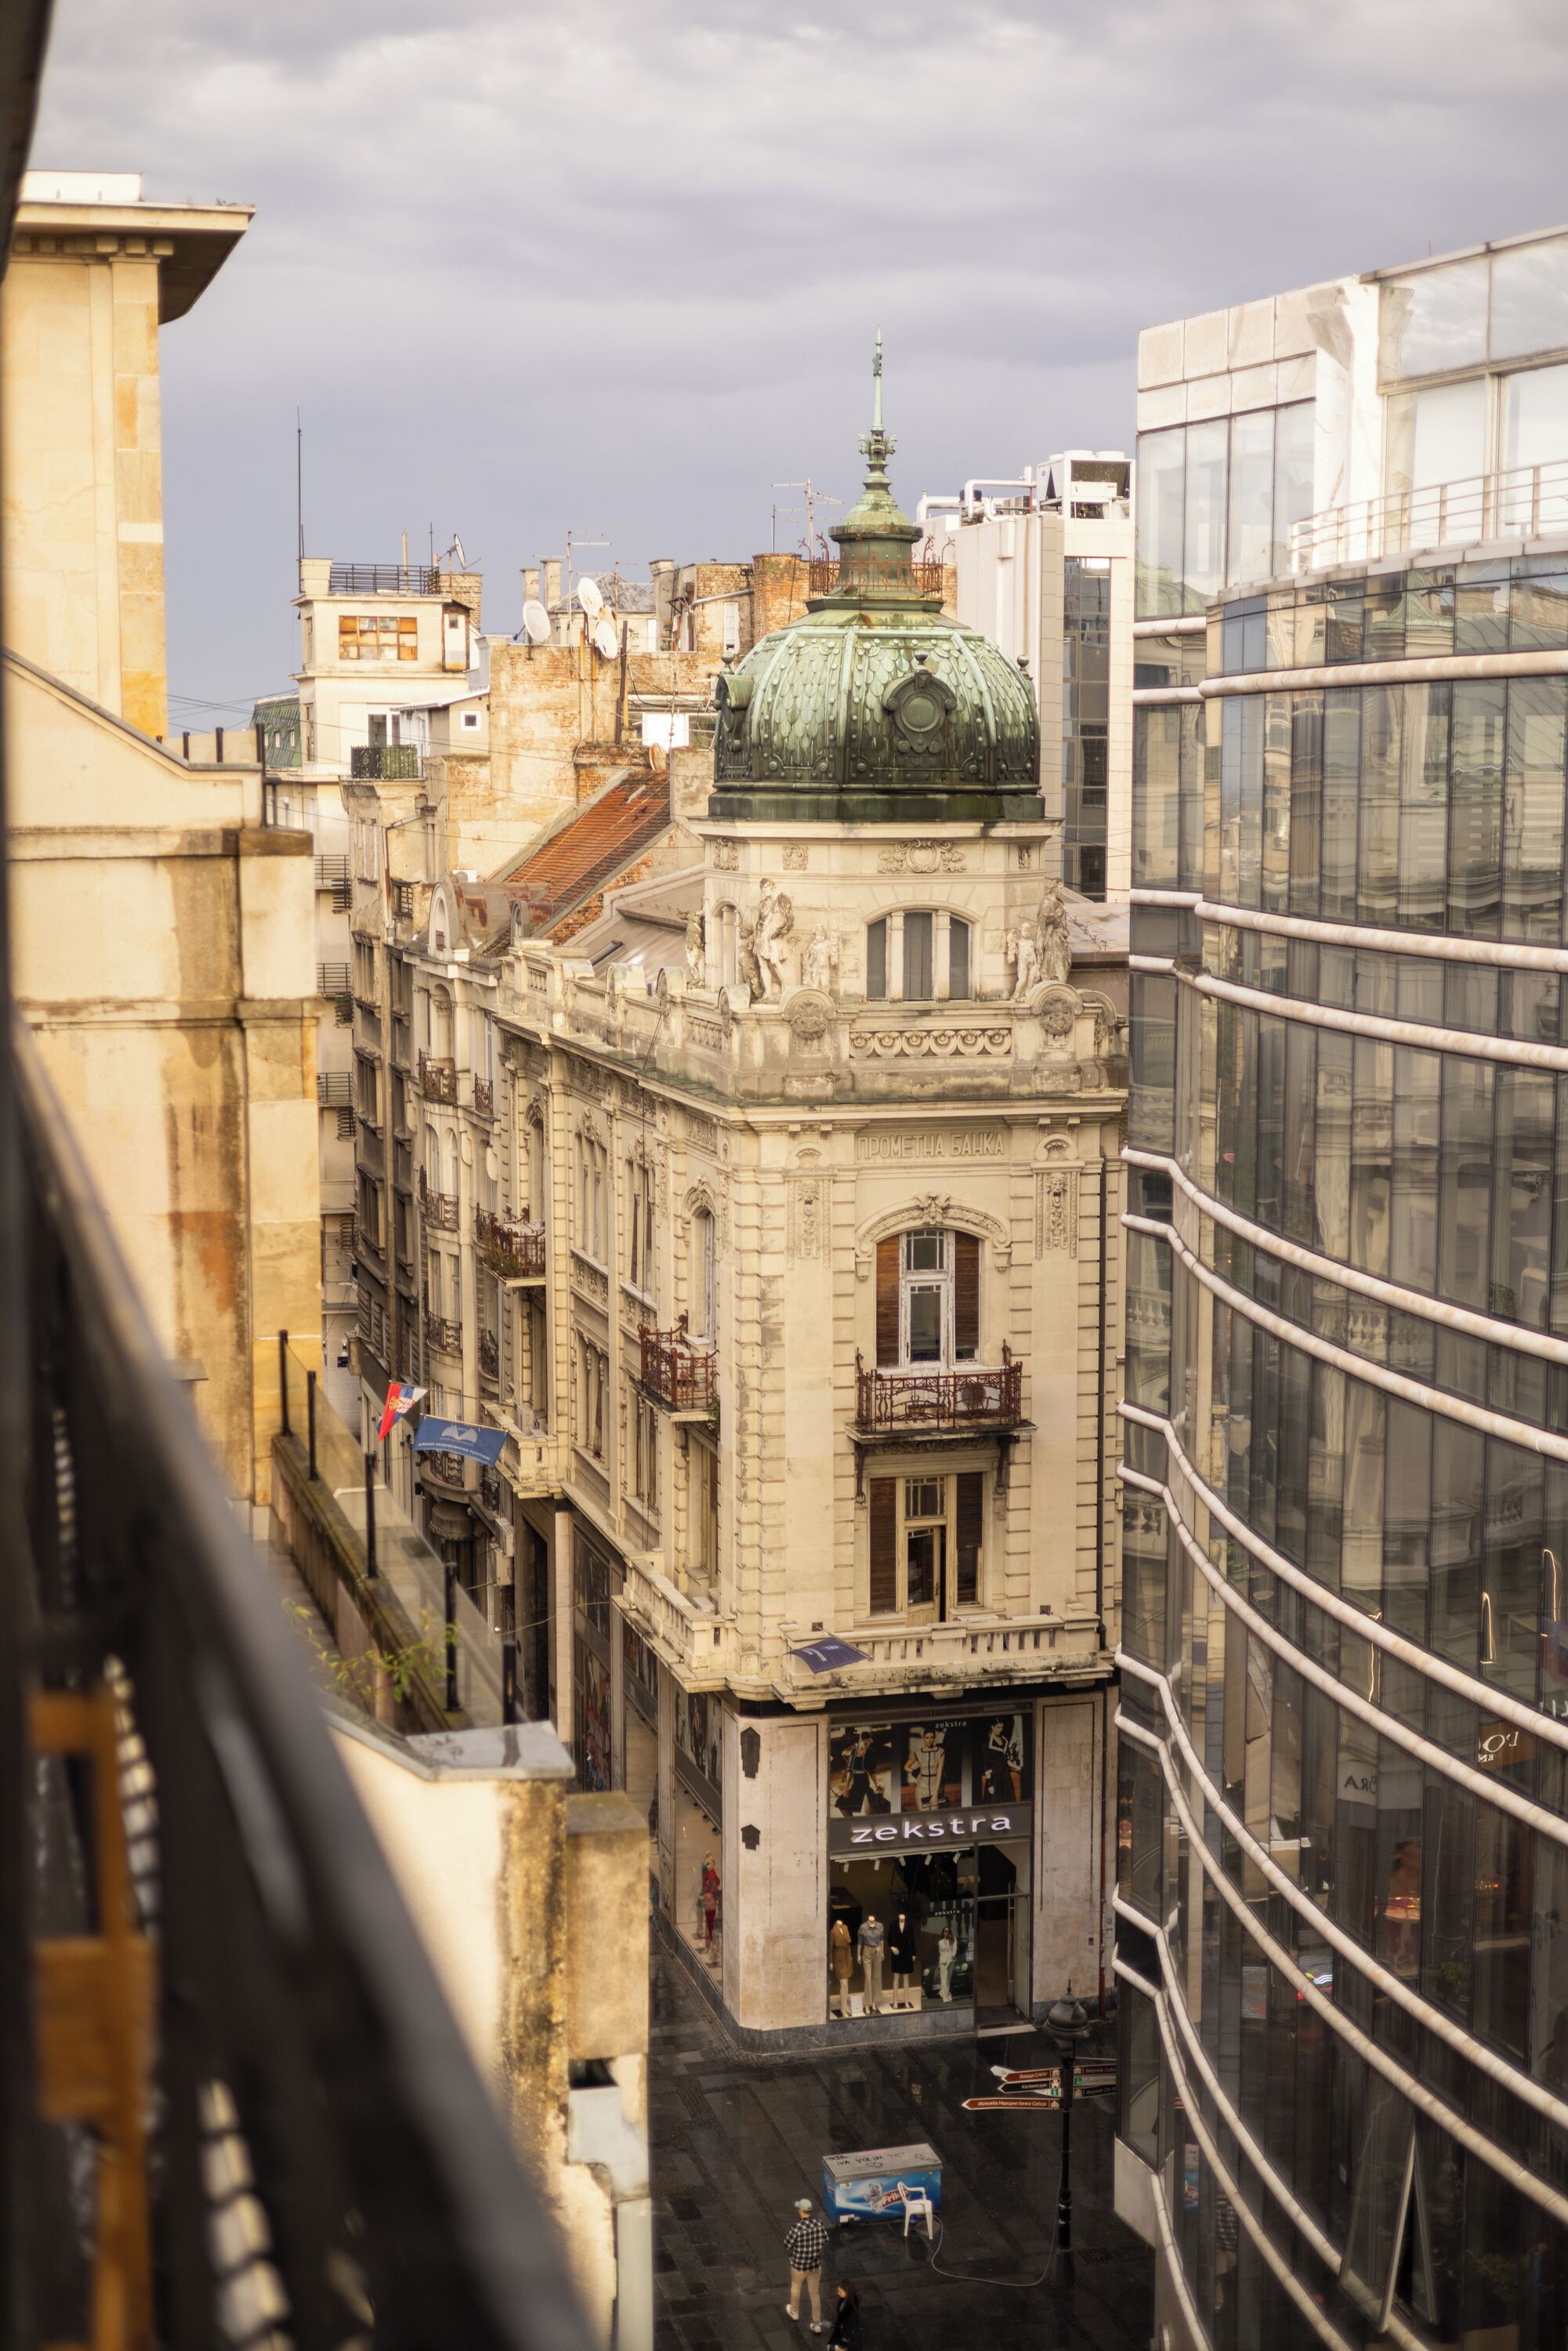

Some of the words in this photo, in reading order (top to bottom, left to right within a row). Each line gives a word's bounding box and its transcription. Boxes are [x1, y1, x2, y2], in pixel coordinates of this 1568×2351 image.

[857, 1133, 944, 1159] ПРОМЕТНА
[951, 1132, 1005, 1157] БАНКА
[852, 1816, 1011, 1843] zekstra
